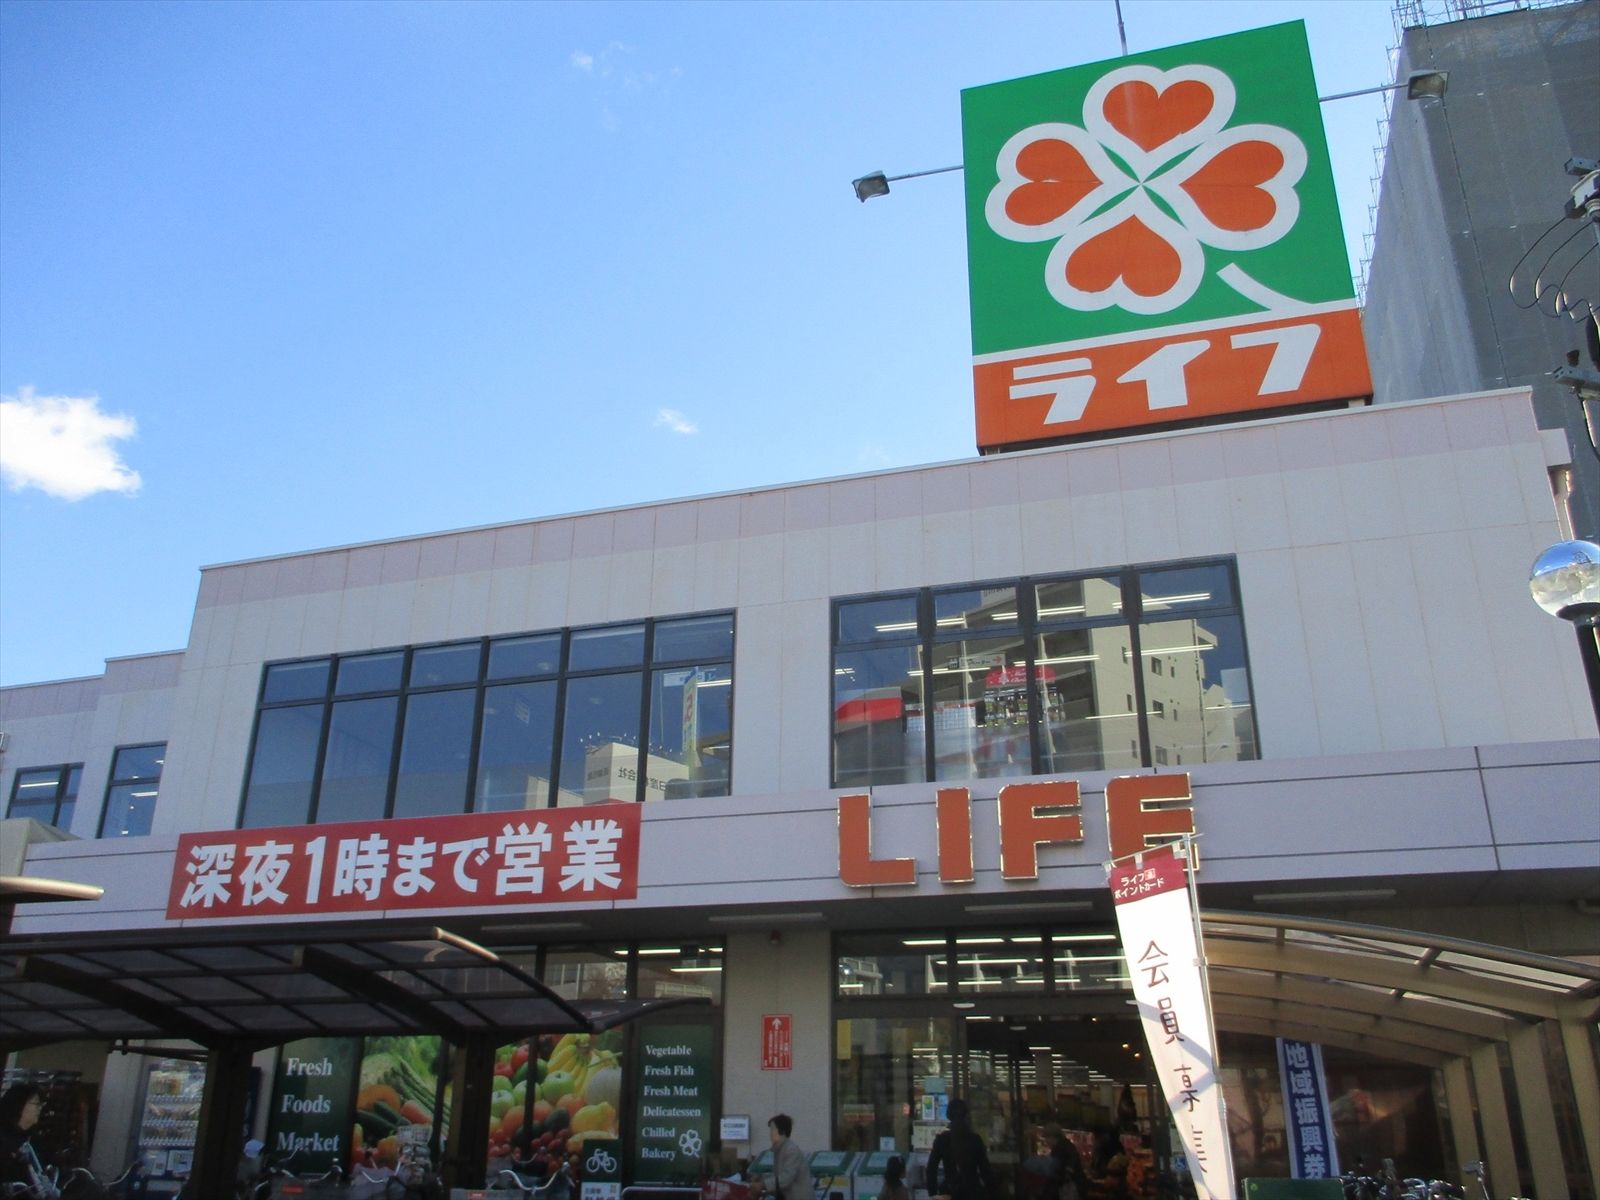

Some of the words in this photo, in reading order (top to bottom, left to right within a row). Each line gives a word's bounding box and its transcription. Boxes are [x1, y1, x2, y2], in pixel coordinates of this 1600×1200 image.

[1009, 323, 1321, 425] ライフ
[837, 772, 1200, 887] LIFE
[179, 818, 624, 908] 深夜1時まで営業
[1120, 872, 1145, 887] ライフ
[645, 1045, 692, 1058] Vegetable
[286, 1057, 333, 1076] Fresh
[644, 1065, 672, 1076] Fresh
[674, 1065, 694, 1076] Fish
[643, 1085, 671, 1096] Fresh
[673, 1086, 698, 1096] Meat
[281, 1094, 331, 1113] Foods
[643, 1106, 702, 1117] Delicatessen
[642, 1127, 676, 1138] Chilled
[276, 1132, 340, 1152] Market
[641, 1147, 676, 1161] Bakery
